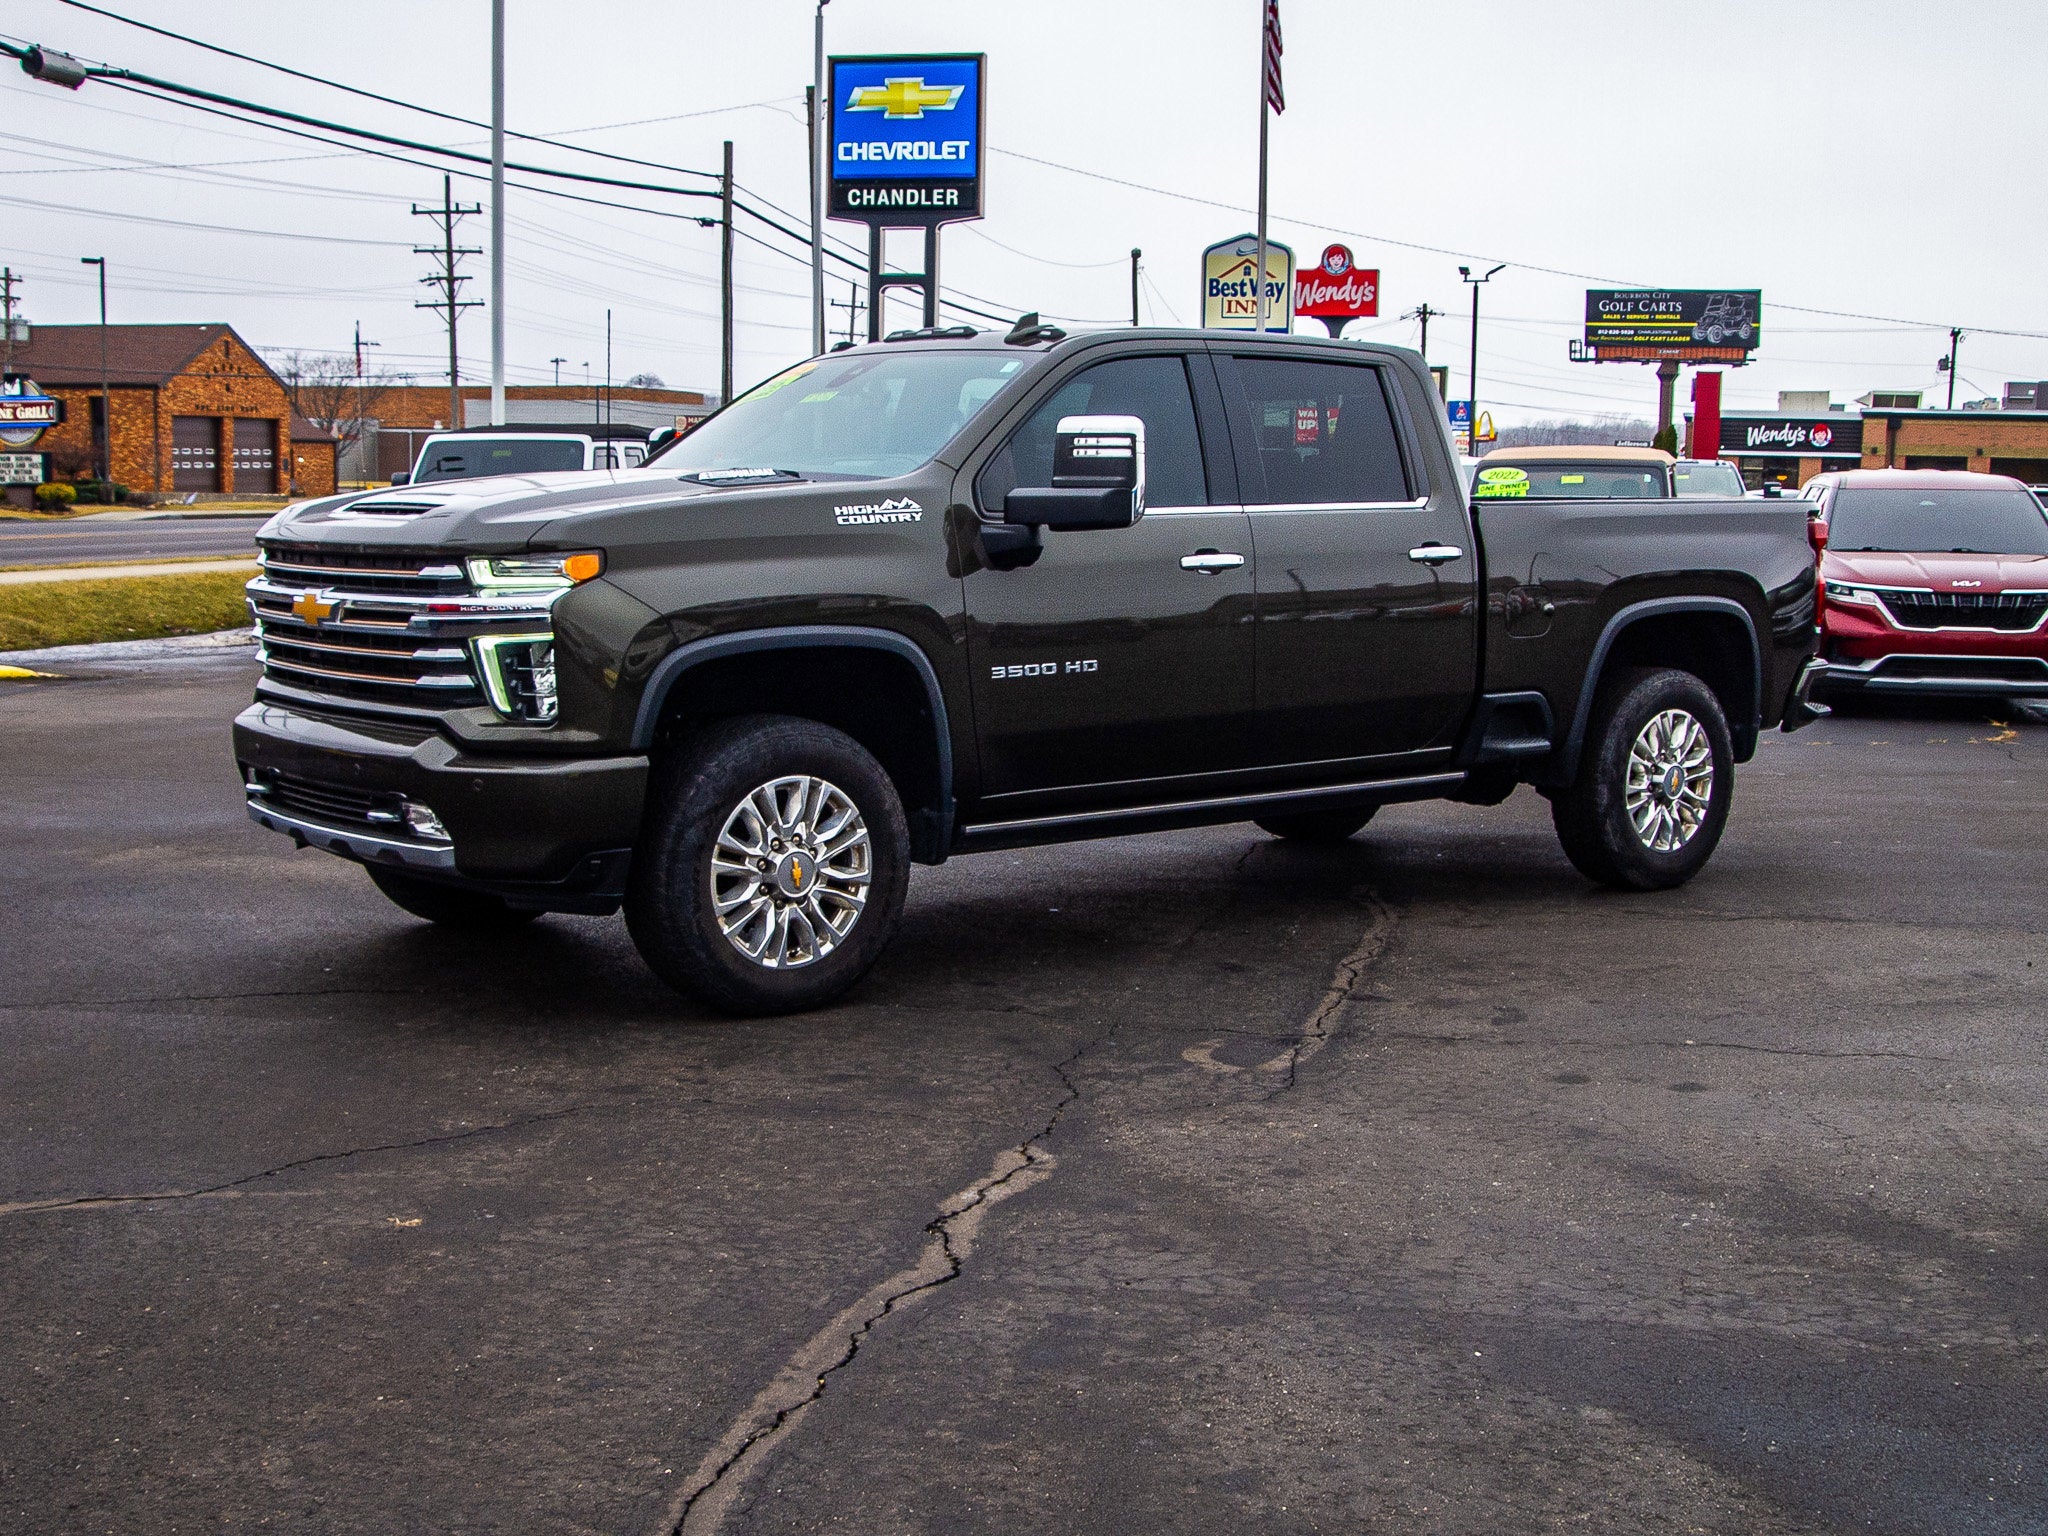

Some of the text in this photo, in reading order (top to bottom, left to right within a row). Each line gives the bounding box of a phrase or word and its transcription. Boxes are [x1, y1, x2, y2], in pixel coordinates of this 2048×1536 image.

[838, 141, 970, 161] CHEVROLET
[847, 188, 959, 206] CHANDLER
[1208, 278, 1247, 297] Best
[1296, 276, 1374, 309] Wendy's
[16, 405, 49, 420] GRILL
[1747, 422, 1807, 447] Wendy's
[1488, 471, 1519, 480] 2022
[1499, 482, 1528, 490] OWNER
[833, 504, 880, 516] HIGH
[836, 512, 923, 525] COUNTRY
[991, 660, 1098, 679] 3500 HD
